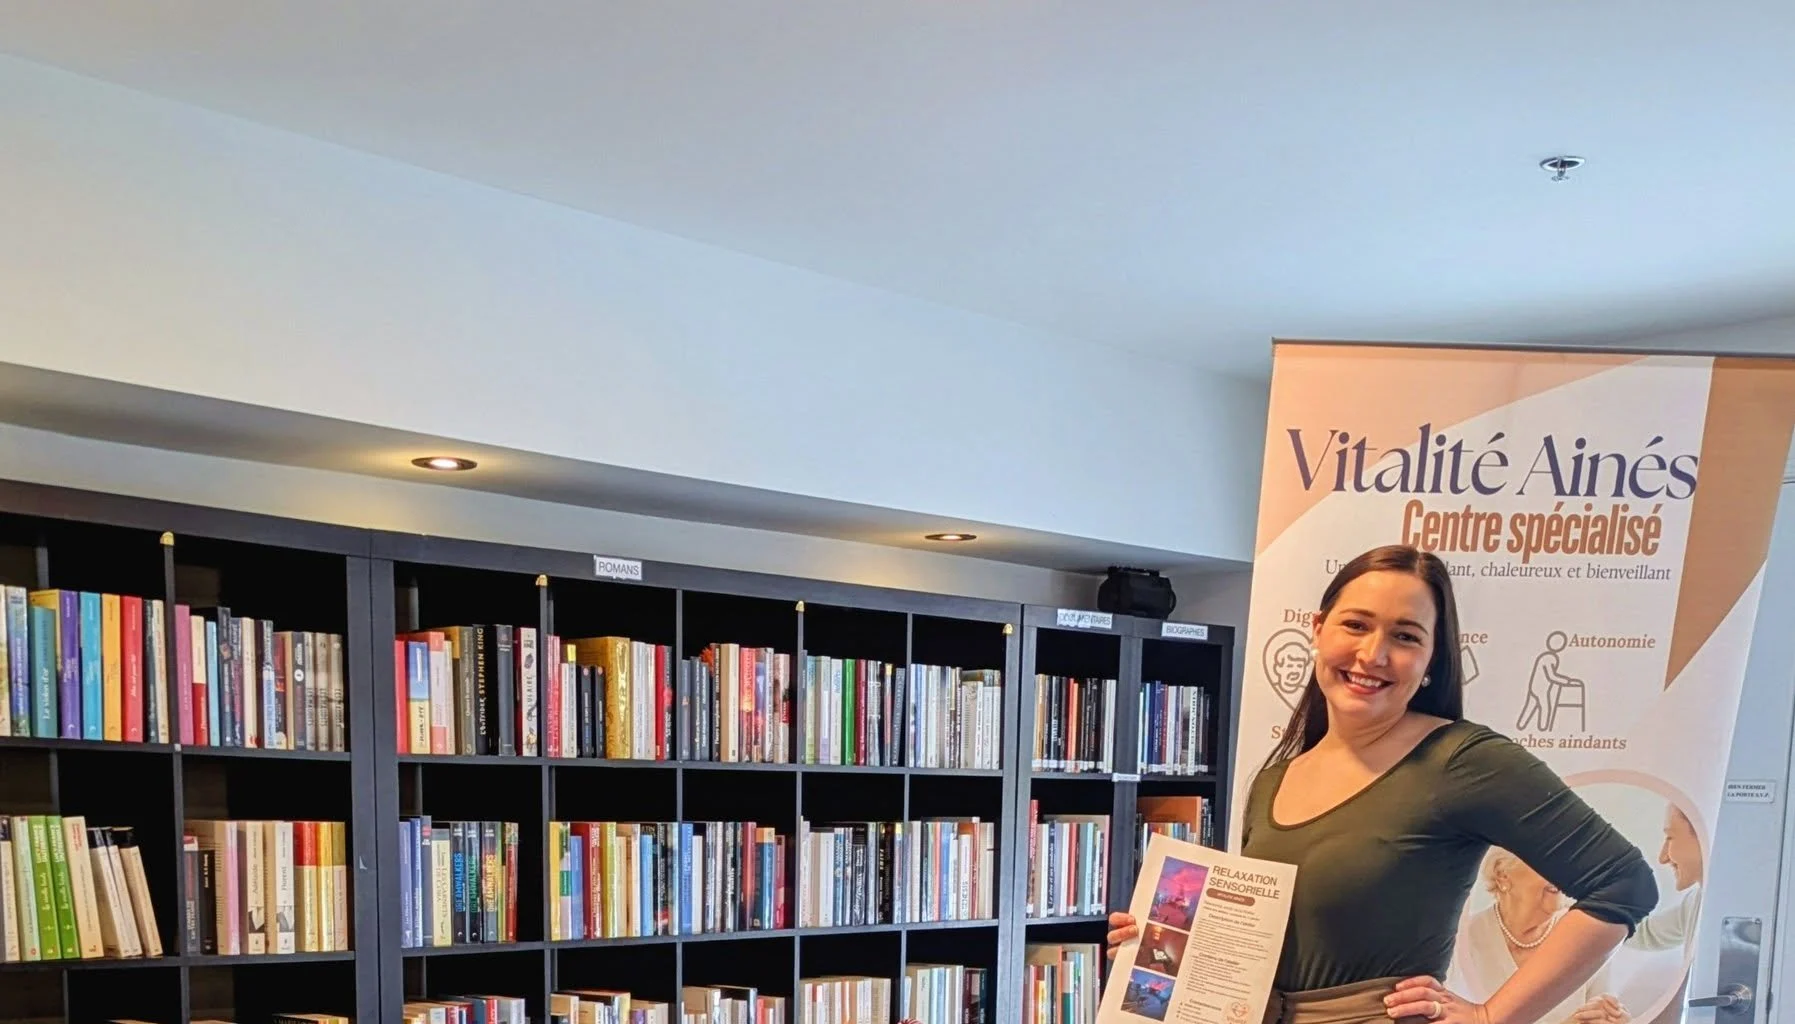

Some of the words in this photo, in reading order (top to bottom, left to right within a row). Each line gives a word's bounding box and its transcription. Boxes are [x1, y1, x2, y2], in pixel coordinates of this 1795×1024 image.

[1287, 422, 1509, 496] Vitalité
[1516, 436, 1699, 500] Ainés
[1401, 500, 1501, 552] Centre
[1507, 503, 1661, 563] spécialisé
[598, 561, 640, 576] ROMANS
[1480, 562, 1562, 578] chaleureux
[1567, 566, 1581, 578] et
[1586, 563, 1671, 580] bienveillant
[475, 628, 484, 650] KING
[1568, 633, 1656, 649] Autonomie
[41, 668, 49, 684] d'or
[476, 653, 484, 695] STEPHEN
[42, 684, 50, 707] violon
[42, 708, 50, 720] Le
[1558, 735, 1627, 750] aindants
[453, 853, 463, 912] DREAMWALKERS
[469, 855, 478, 913] DREAMWALKERS
[1212, 865, 1278, 886] RELAXATION
[1209, 877, 1280, 899] SENSORIELLE
